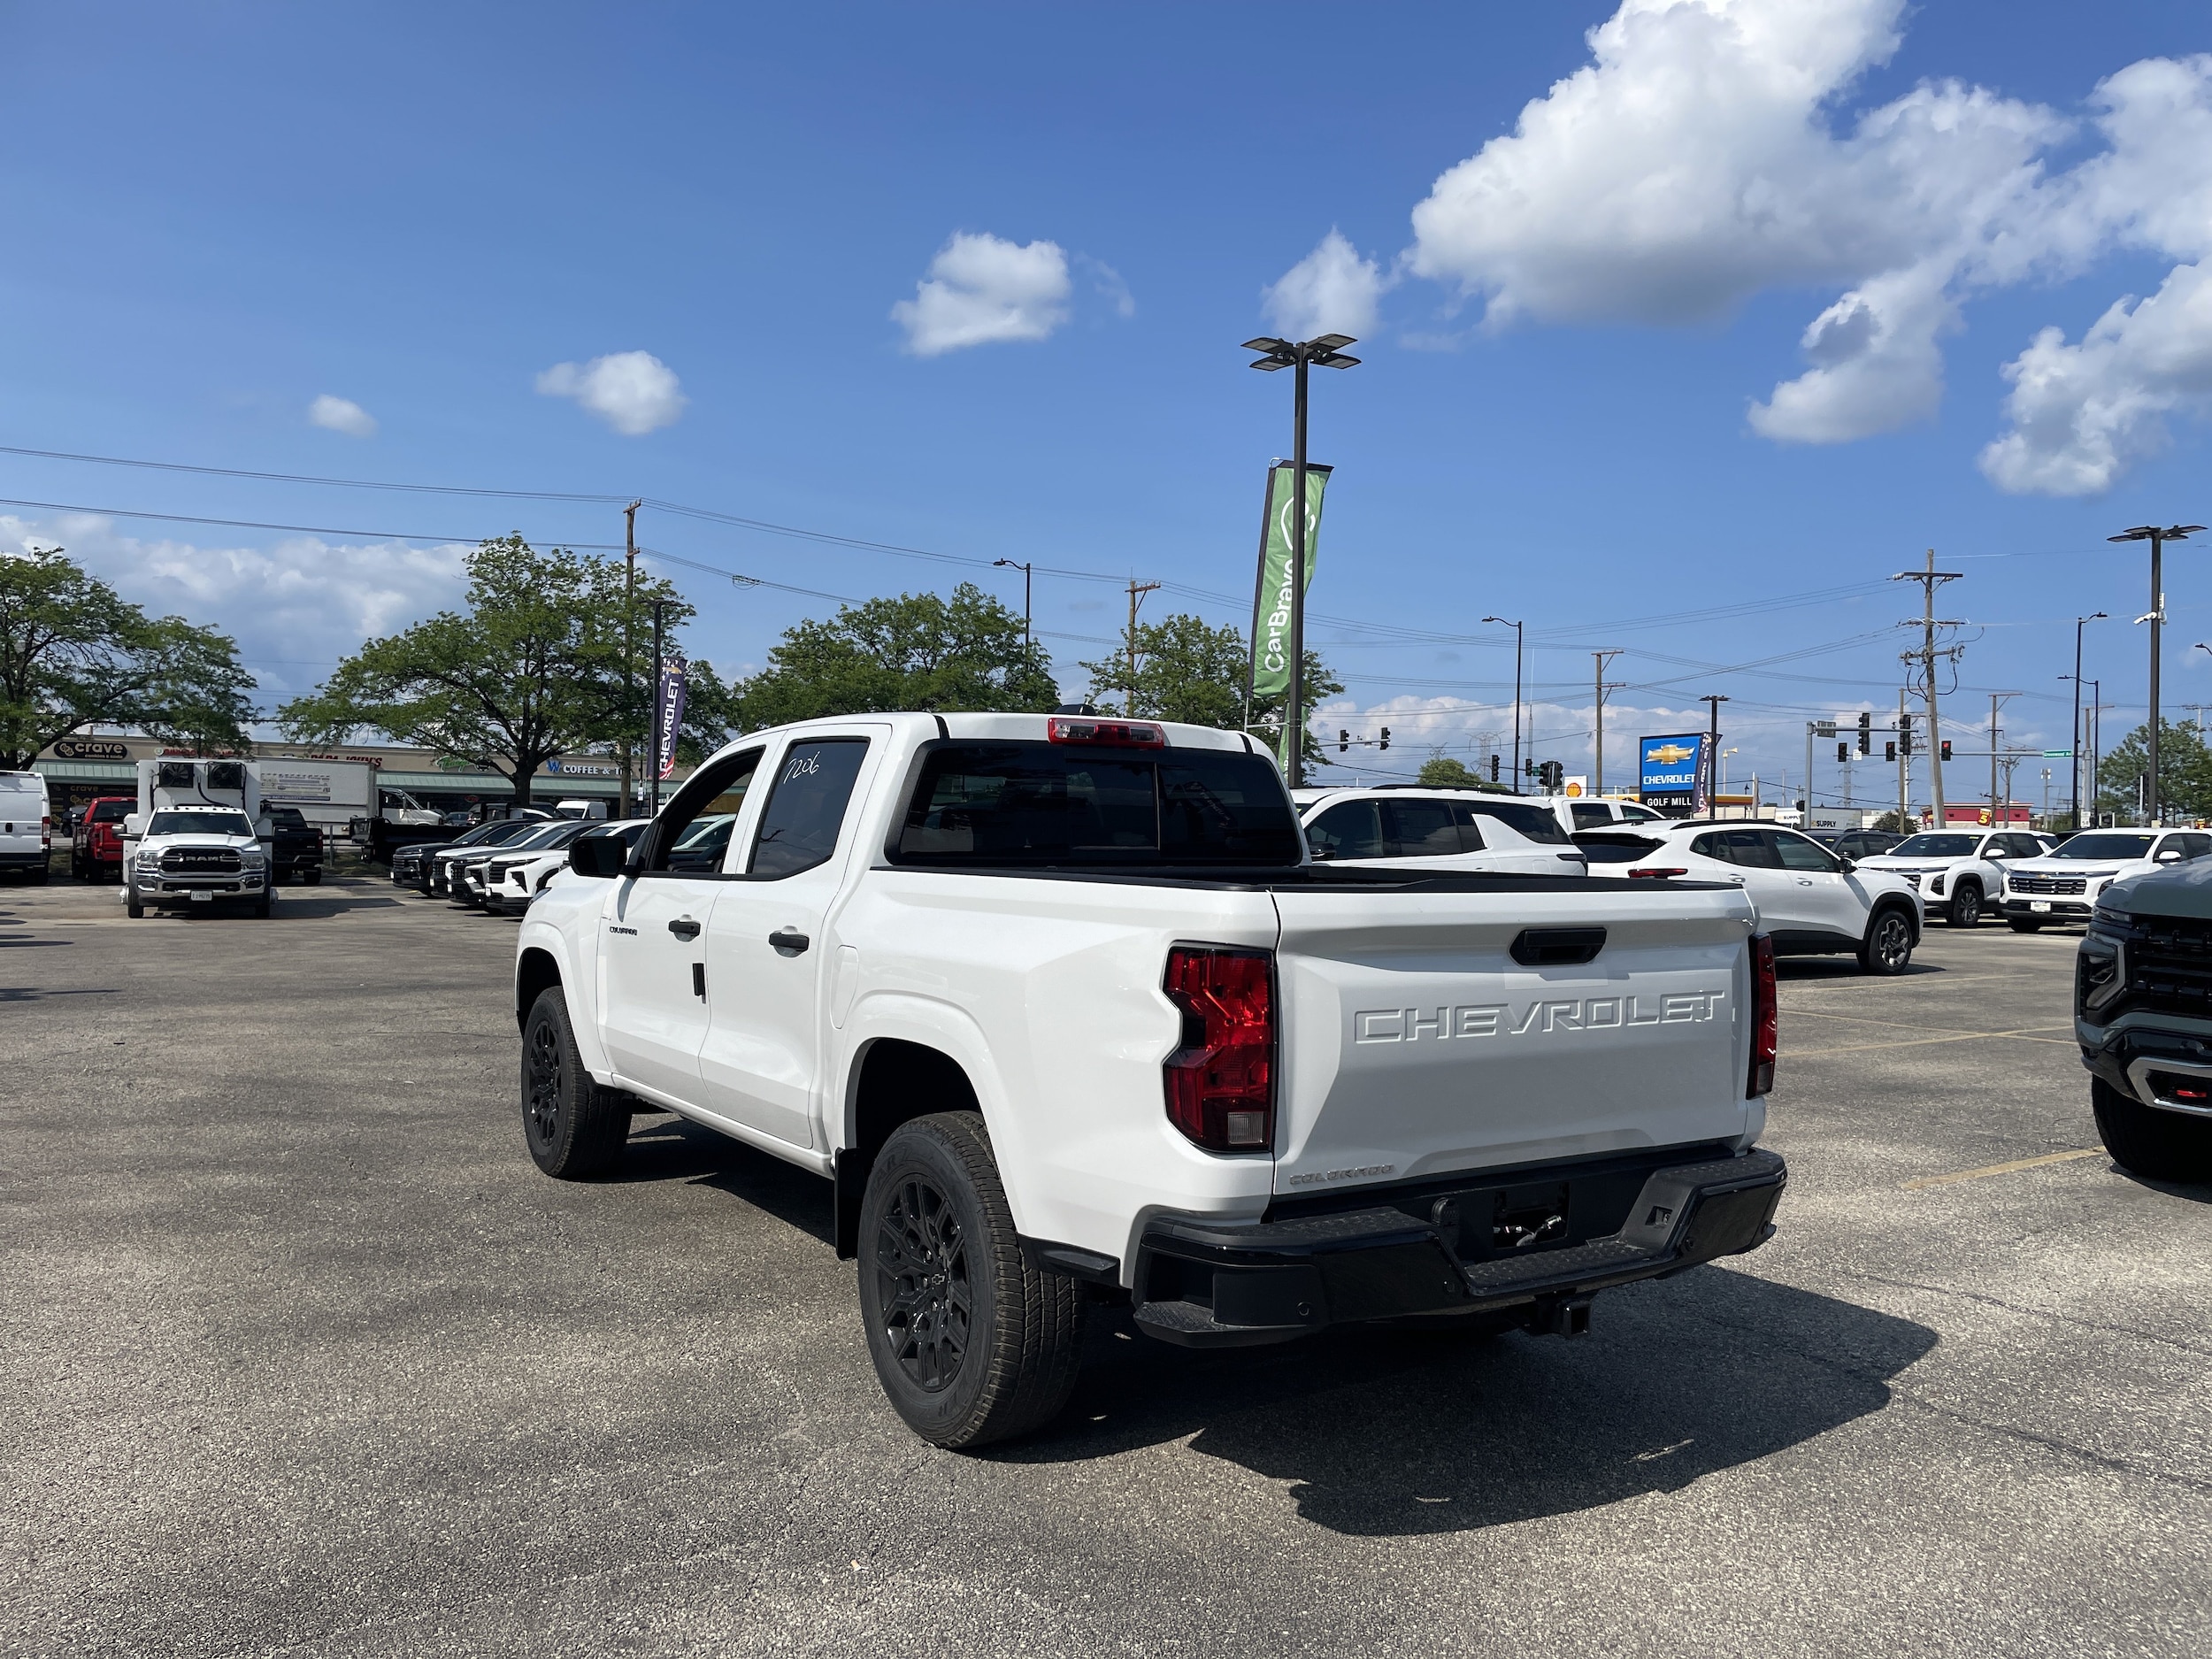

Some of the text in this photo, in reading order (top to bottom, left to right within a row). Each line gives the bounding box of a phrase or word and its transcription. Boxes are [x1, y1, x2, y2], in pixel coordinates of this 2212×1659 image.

[659, 679, 680, 772] CHEVROLET
[74, 742, 123, 754] crave
[563, 764, 599, 774] COFFEE
[1643, 773, 1695, 785] CHEVROLET
[1647, 797, 1692, 807] GOLF MILL
[1355, 990, 1724, 1044] CHEVROLET
[1289, 1164, 1395, 1185] COLORADO
